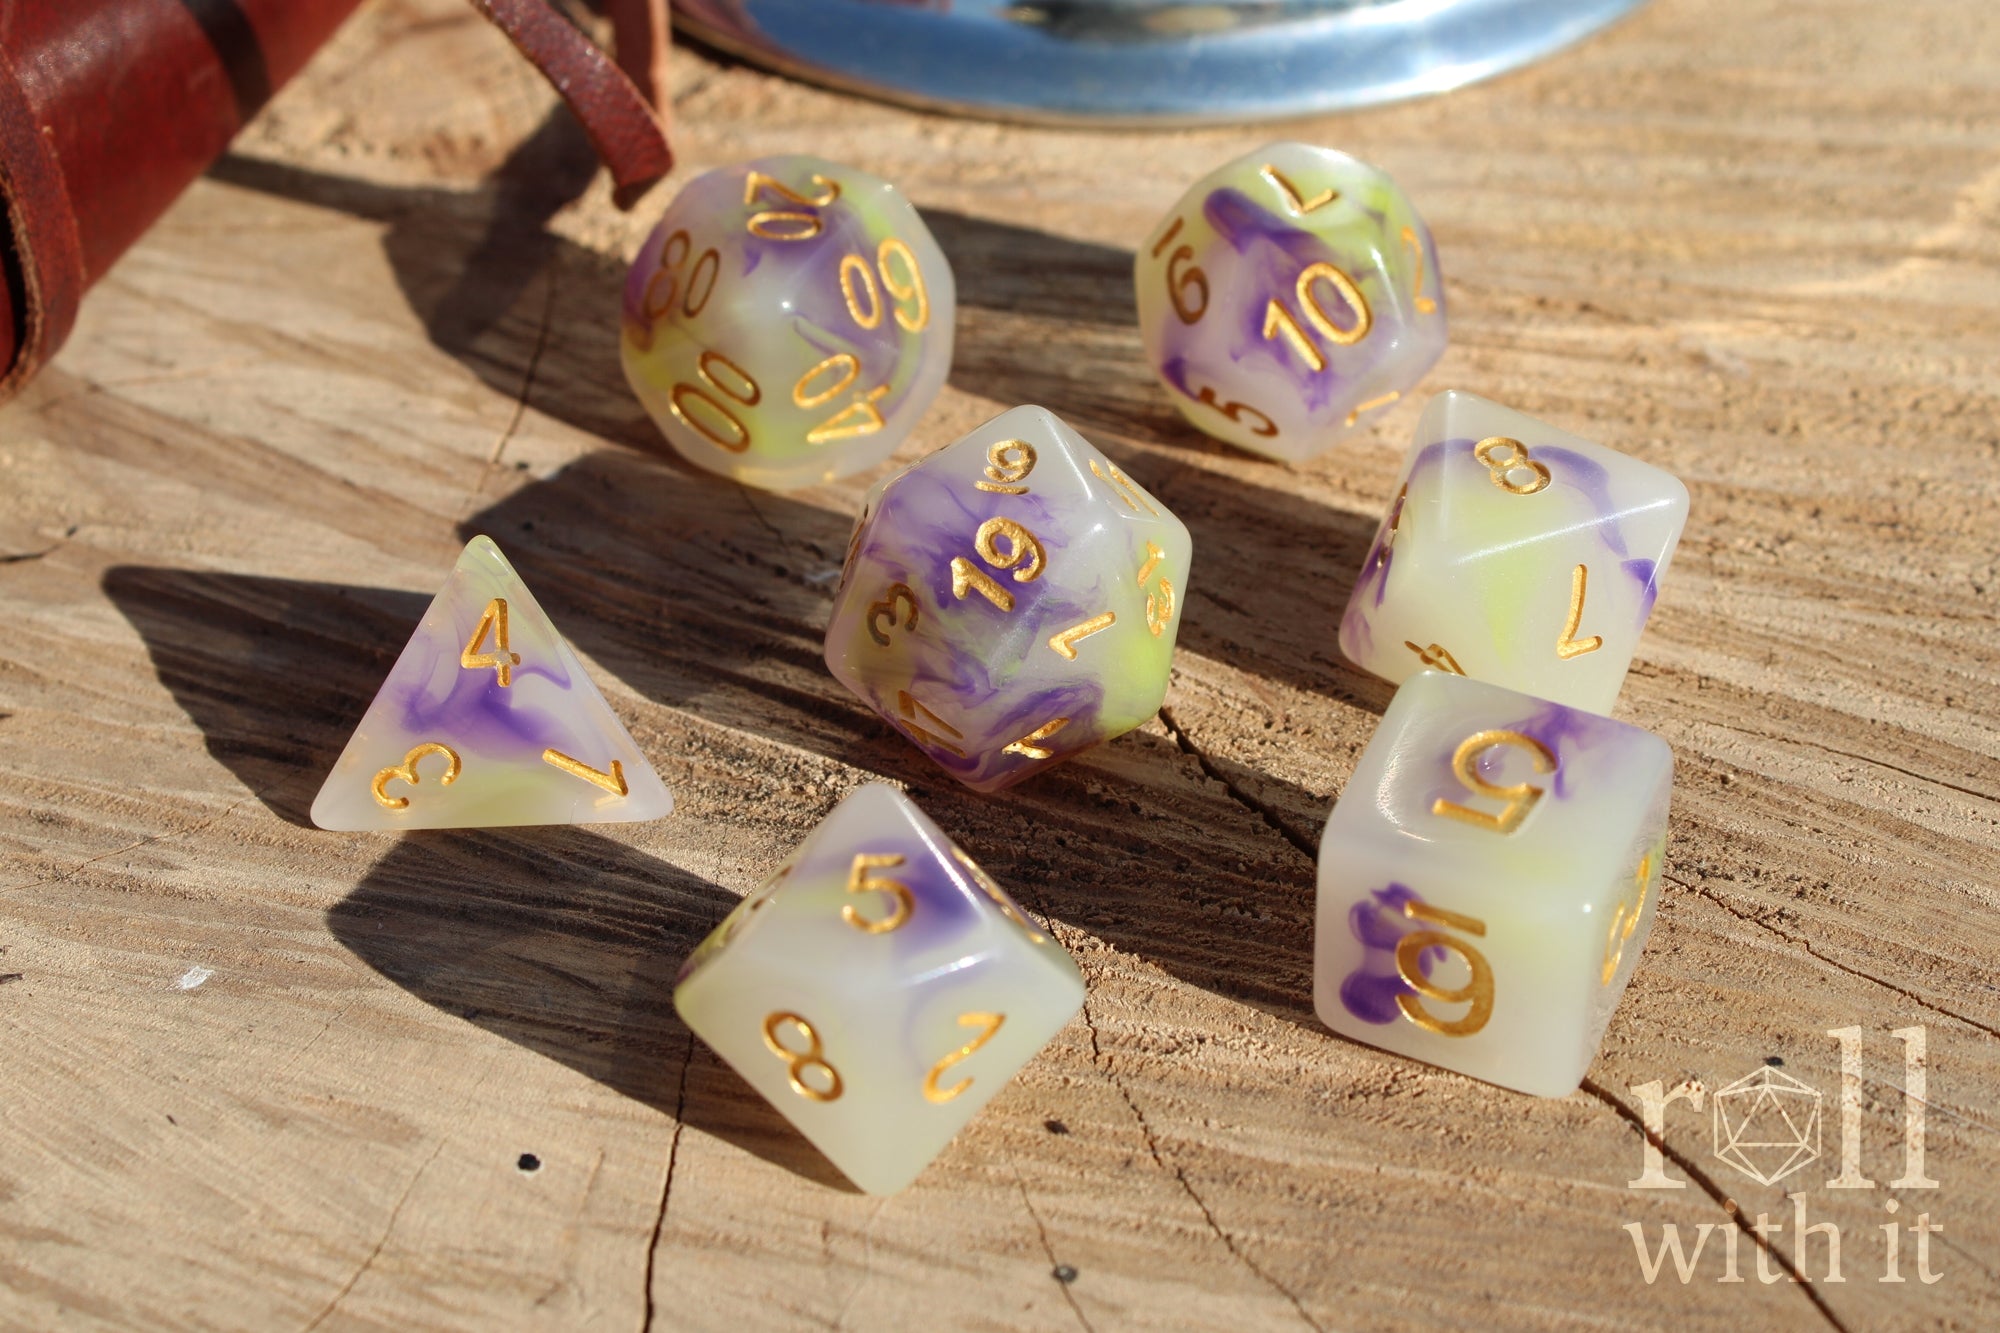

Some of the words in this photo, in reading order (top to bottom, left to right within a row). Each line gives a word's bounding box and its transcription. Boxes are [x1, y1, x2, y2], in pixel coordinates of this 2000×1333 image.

[744, 171, 841, 240] 20
[643, 229, 720, 319] 80
[1262, 262, 1373, 373] 10
[670, 351, 761, 453] 00
[793, 353, 891, 444] 40
[1474, 437, 1552, 495] 8
[950, 516, 1048, 612] 19
[461, 598, 520, 688] 4
[867, 583, 919, 647] 3
[1557, 563, 1603, 660] 7
[371, 742, 462, 809] 3
[1431, 729, 1557, 836] 5
[842, 853, 916, 934] 5
[762, 1011, 844, 1103] 8
[923, 1012, 1007, 1104] 2
